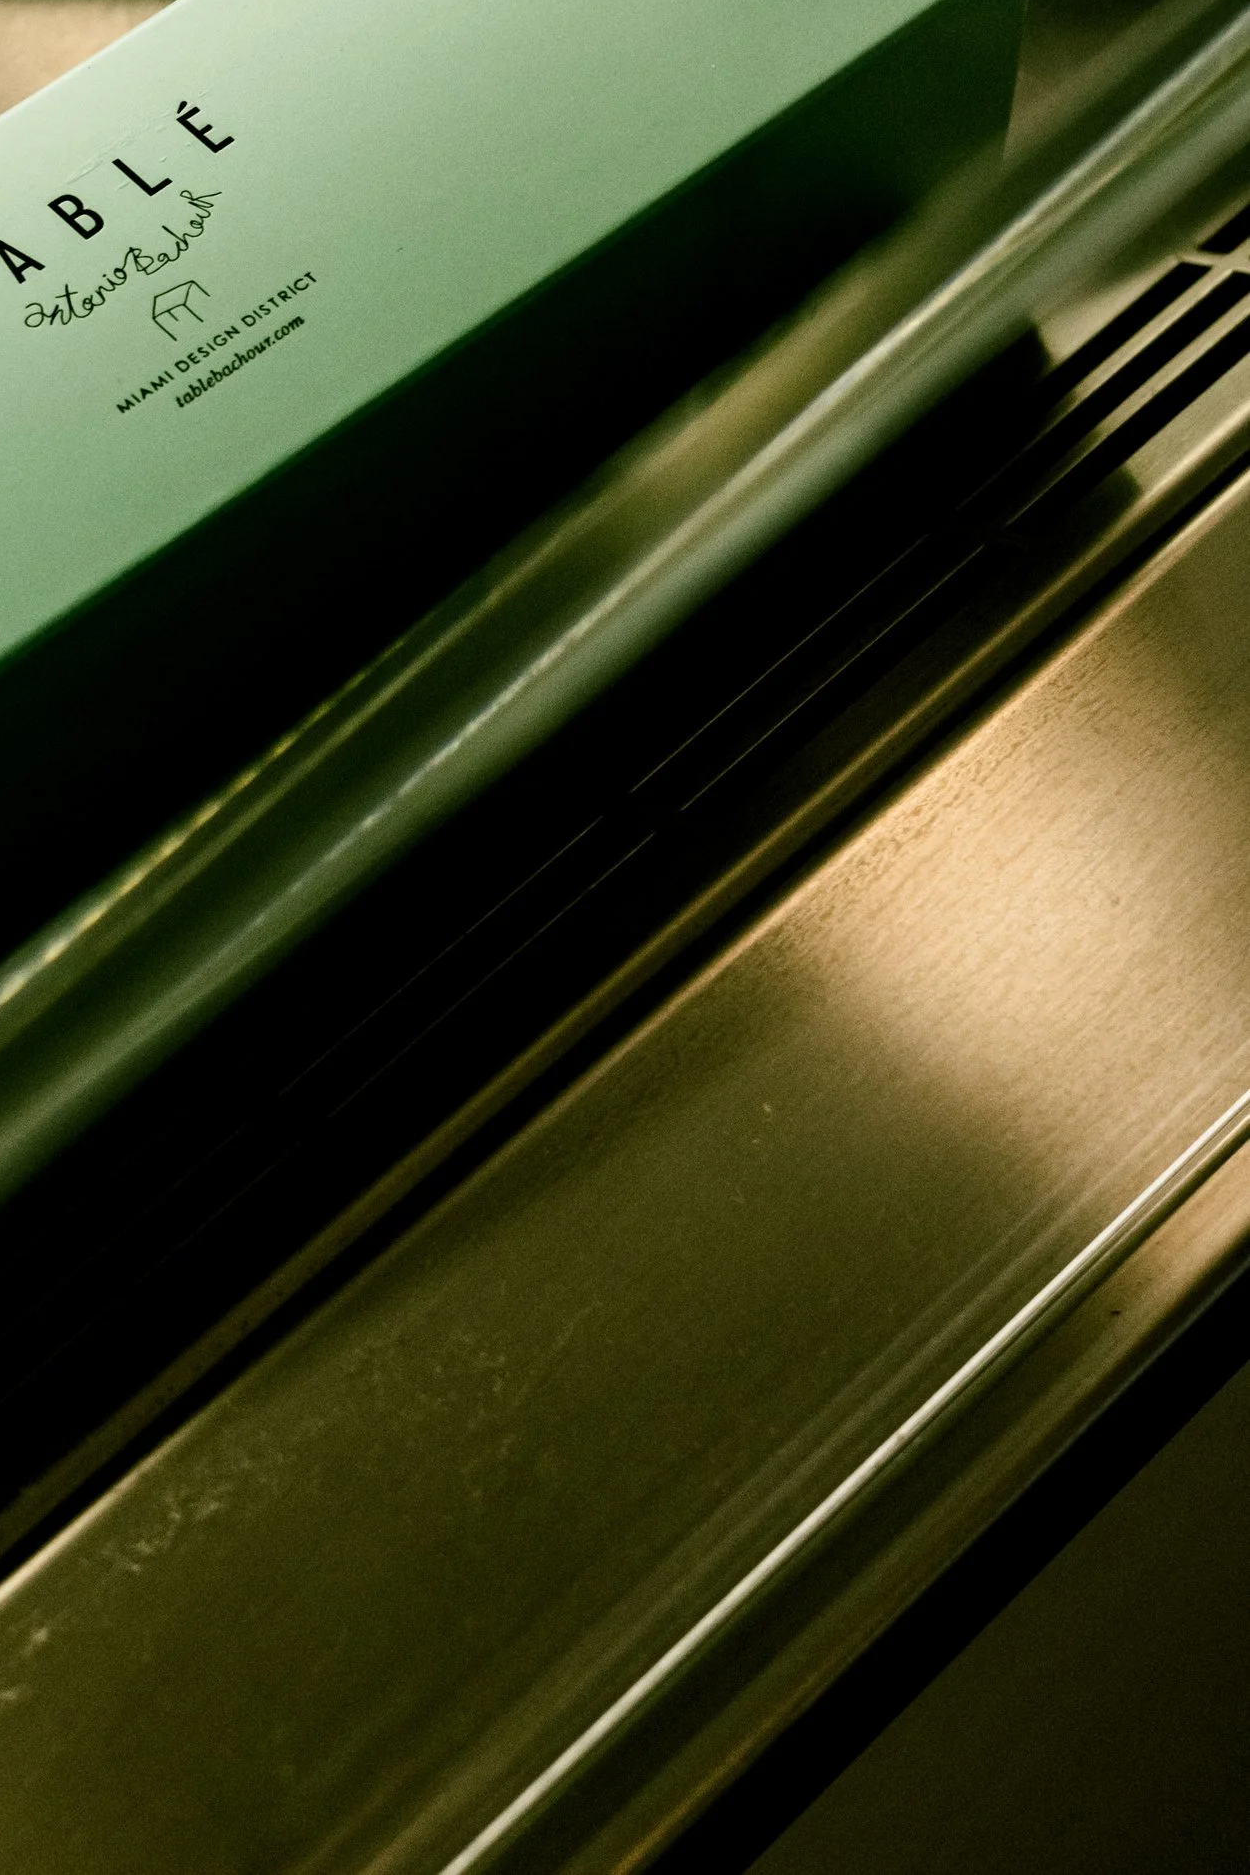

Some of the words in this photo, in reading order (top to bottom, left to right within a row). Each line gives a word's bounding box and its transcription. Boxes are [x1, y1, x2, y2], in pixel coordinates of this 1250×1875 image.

[116, 371, 175, 414] MIAMI
[175, 326, 240, 373] DESIGN
[241, 272, 317, 327] DISTRICT
[175, 316, 305, 408] tablebachour.com
